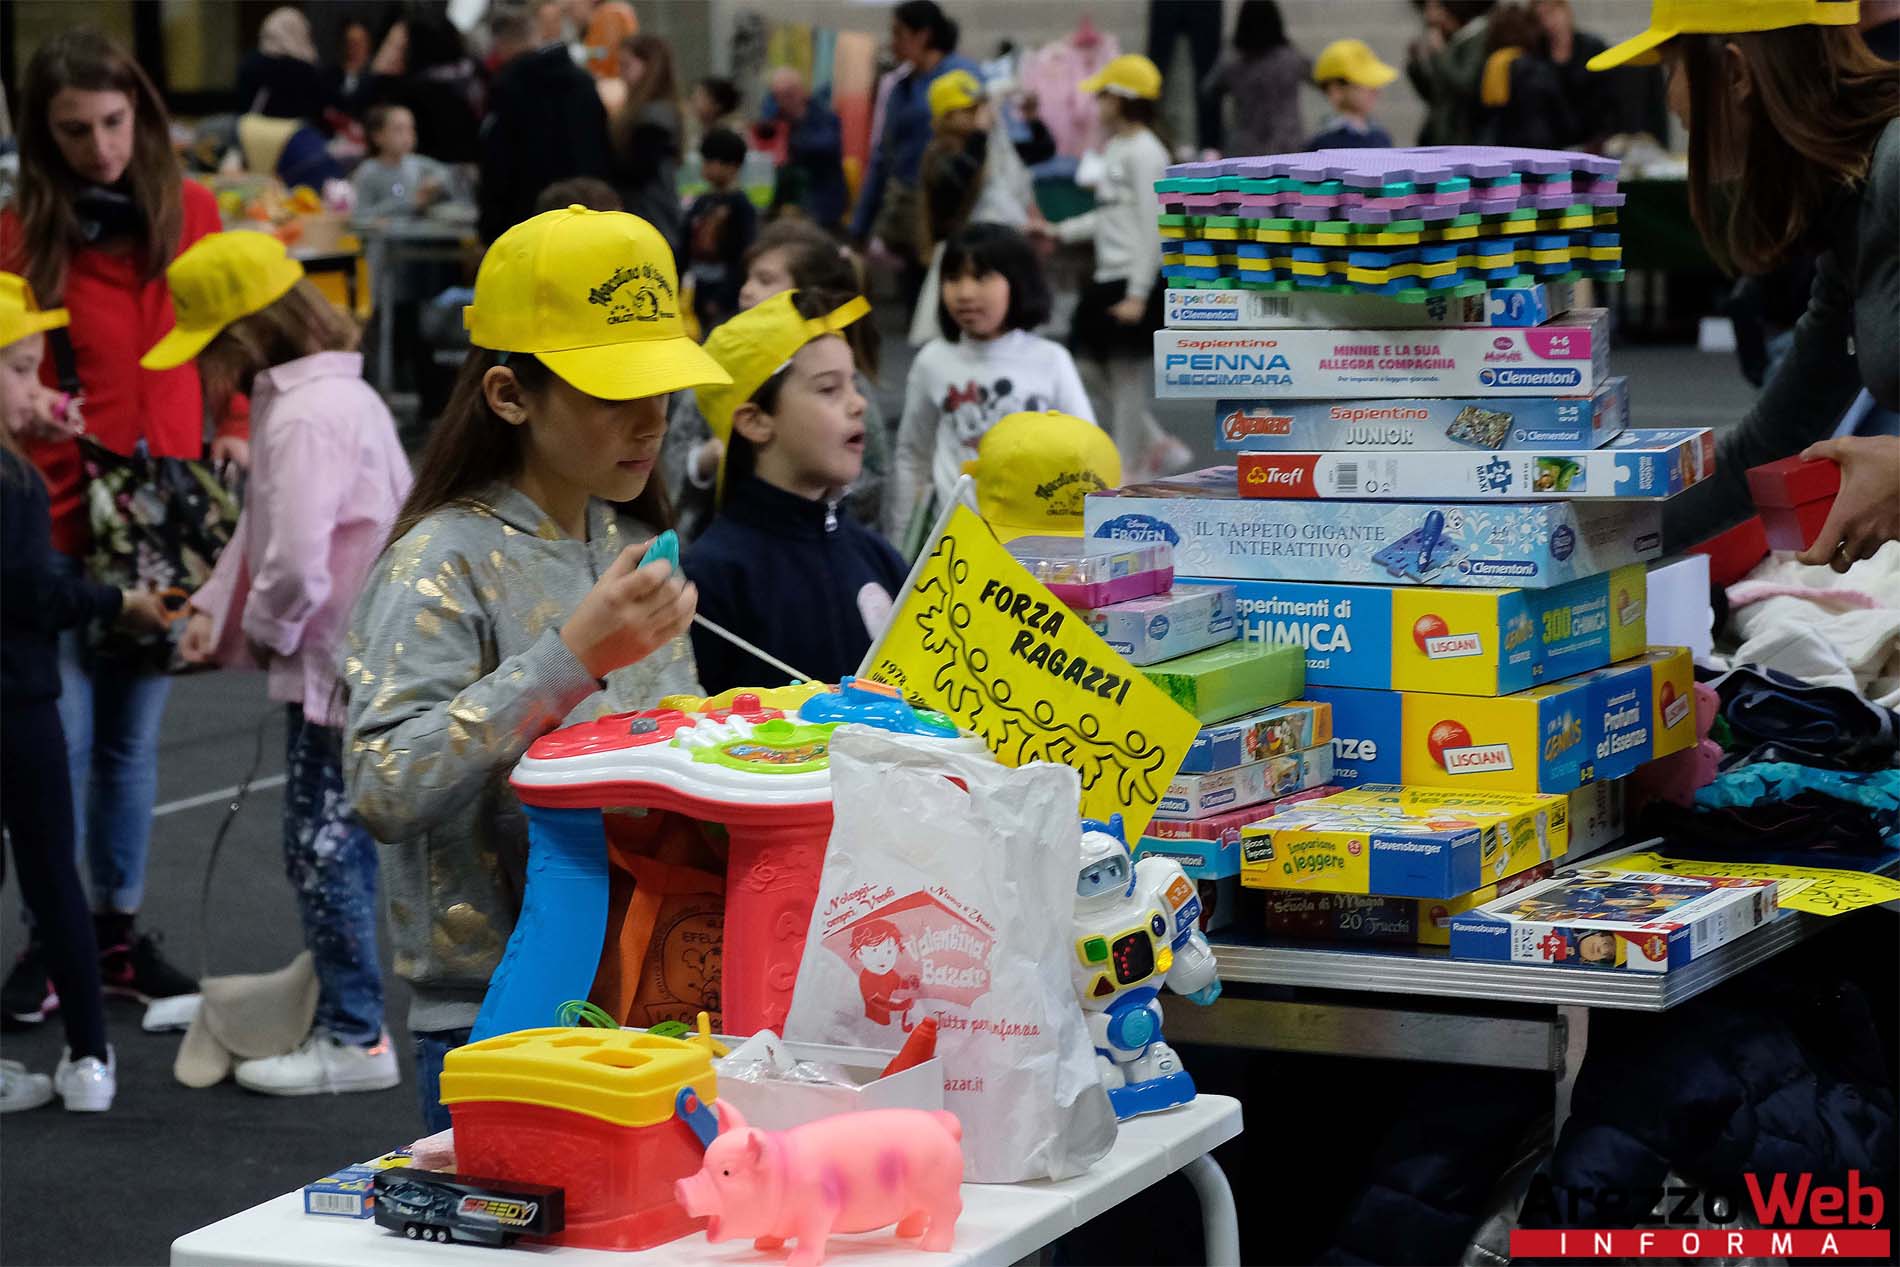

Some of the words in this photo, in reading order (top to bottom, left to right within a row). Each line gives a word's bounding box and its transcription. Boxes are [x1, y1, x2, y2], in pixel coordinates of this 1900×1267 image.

[1181, 309, 1238, 320] Clementoni
[1177, 339, 1278, 350] Sapientino
[1333, 345, 1379, 356] MINNIE
[1383, 345, 1391, 356] E
[1395, 345, 1410, 356] LA
[1414, 344, 1441, 356] SUA
[1165, 354, 1291, 371] PENNA
[1318, 359, 1375, 370] ALLEGRA
[1378, 358, 1455, 370] COMPAGNIA
[1498, 370, 1577, 385] Clementoni
[1330, 406, 1429, 422] Sapientino
[1345, 427, 1414, 445] JUNIOR
[1527, 430, 1580, 442] Clementoni
[1267, 466, 1304, 484] Trefl
[1476, 465, 1488, 493] MAXI
[1196, 521, 1213, 537] IL
[1217, 522, 1297, 540] TAPPETO
[1302, 524, 1386, 542] GIGANTE
[1229, 540, 1352, 559] INTERATTIVO
[1472, 562, 1534, 575] Clementoni
[980, 578, 1065, 638] FORZA
[1235, 595, 1329, 617] sperimenti
[1334, 599, 1351, 618] di
[1239, 619, 1352, 654] HIMICA
[1431, 638, 1477, 655] LISCIANI
[1010, 628, 1132, 706] RAGAZZI
[1305, 657, 1330, 670] nza!
[1603, 701, 1641, 733] Profumi
[1332, 736, 1377, 762] nze
[1595, 733, 1610, 759] ed
[1611, 728, 1648, 755] Essenze
[1448, 750, 1507, 768] LISCIANI
[1286, 838, 1337, 855] Impariamo
[1372, 838, 1443, 856] Ravensburger
[1283, 861, 1293, 875] a
[1293, 854, 1345, 873] leggere
[1339, 912, 1363, 930] 20
[1452, 922, 1508, 936] Ravensburger
[903, 924, 985, 962] Valentina
[921, 958, 986, 988] Bazar
[943, 1076, 984, 1092] azar.it
[463, 1198, 529, 1219] SPEEDY
